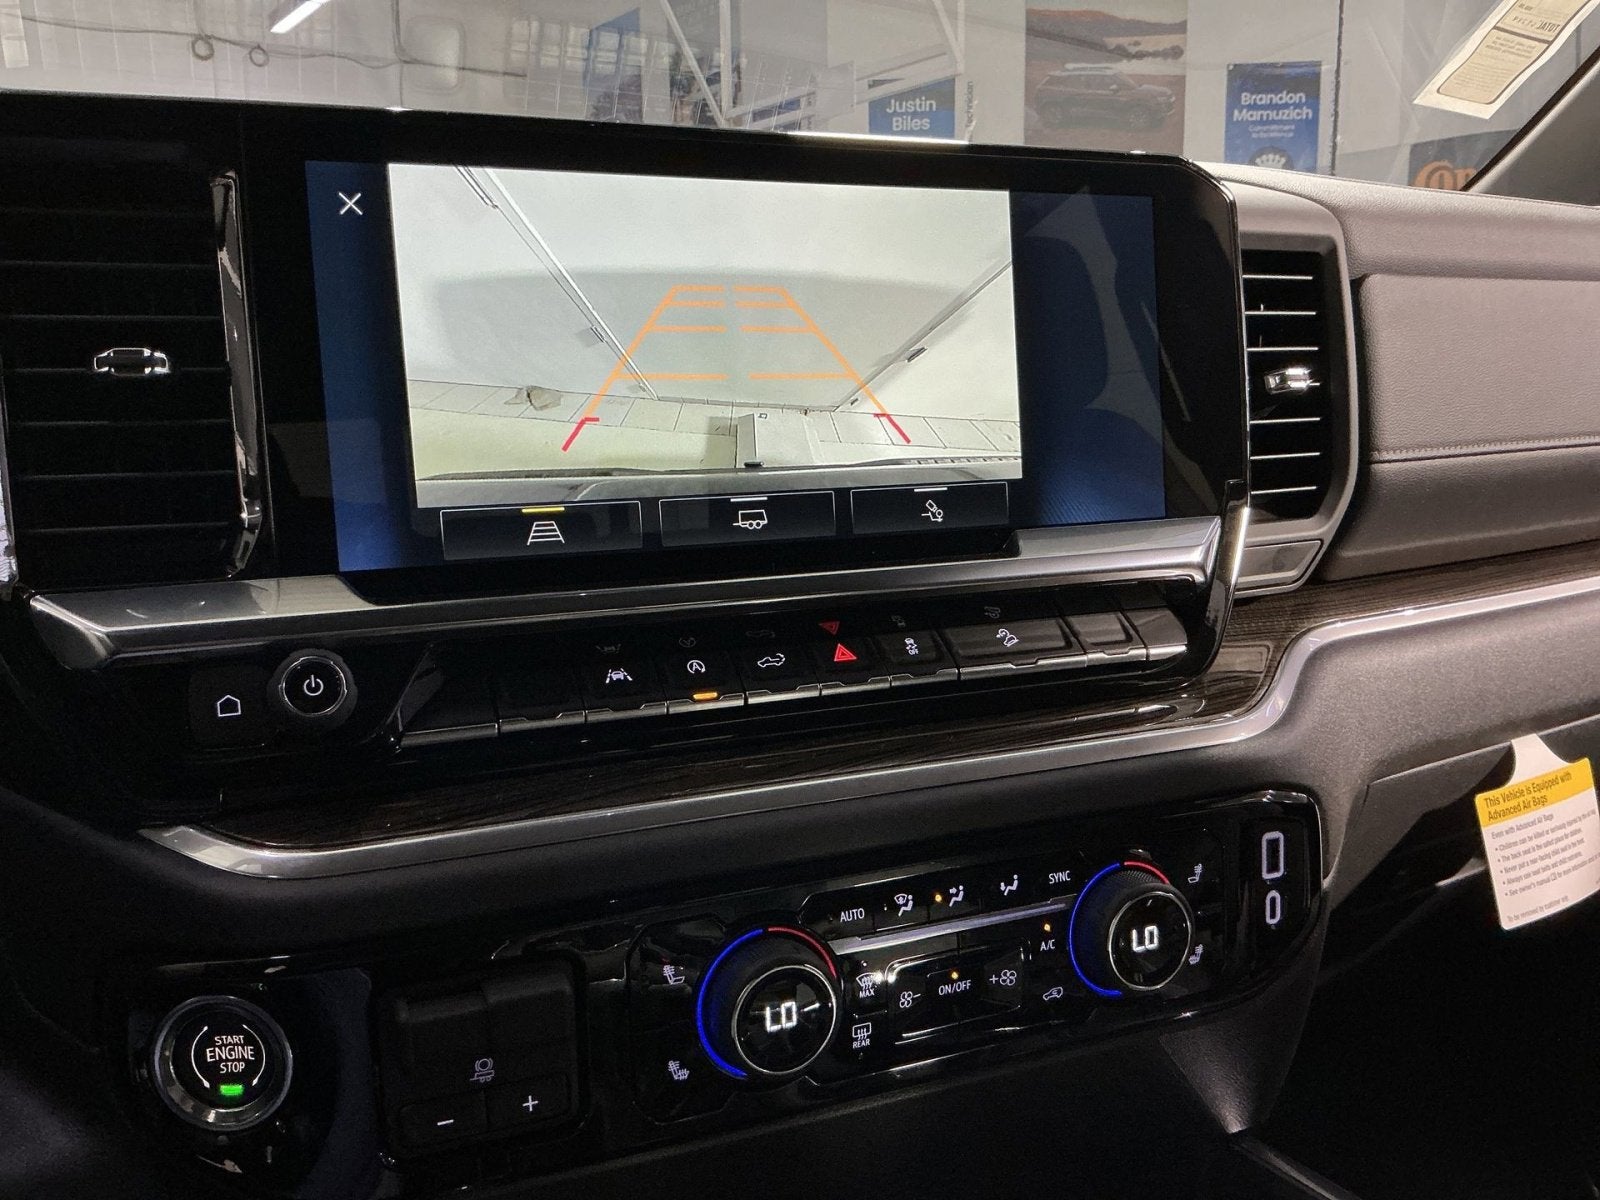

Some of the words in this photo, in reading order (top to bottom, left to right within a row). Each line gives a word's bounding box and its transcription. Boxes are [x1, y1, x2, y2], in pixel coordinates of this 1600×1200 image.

[886, 96, 936, 113] Justin
[1241, 90, 1305, 105] Brandon
[1233, 106, 1312, 121] Mamuzich
[892, 115, 930, 131] Biles
[1484, 796, 1500, 808] This
[1501, 788, 1525, 802] Vehicle
[1525, 786, 1532, 795] is
[1532, 776, 1559, 793] Equipped
[1560, 771, 1572, 783] with
[1488, 802, 1521, 821] Advanced
[1522, 799, 1531, 810] Air
[1532, 795, 1548, 806] Bags
[1048, 870, 1071, 884] SYNC
[840, 908, 865, 923] AUTO
[1040, 939, 1056, 951] A/C
[1132, 925, 1159, 953] LO
[859, 988, 875, 998] MAX
[938, 979, 972, 995] ON/OFF
[765, 1001, 797, 1033] LO
[214, 1035, 245, 1046] START
[852, 1038, 871, 1049] REAR
[206, 1045, 255, 1062] ENGINE
[220, 1061, 245, 1074] STOP
